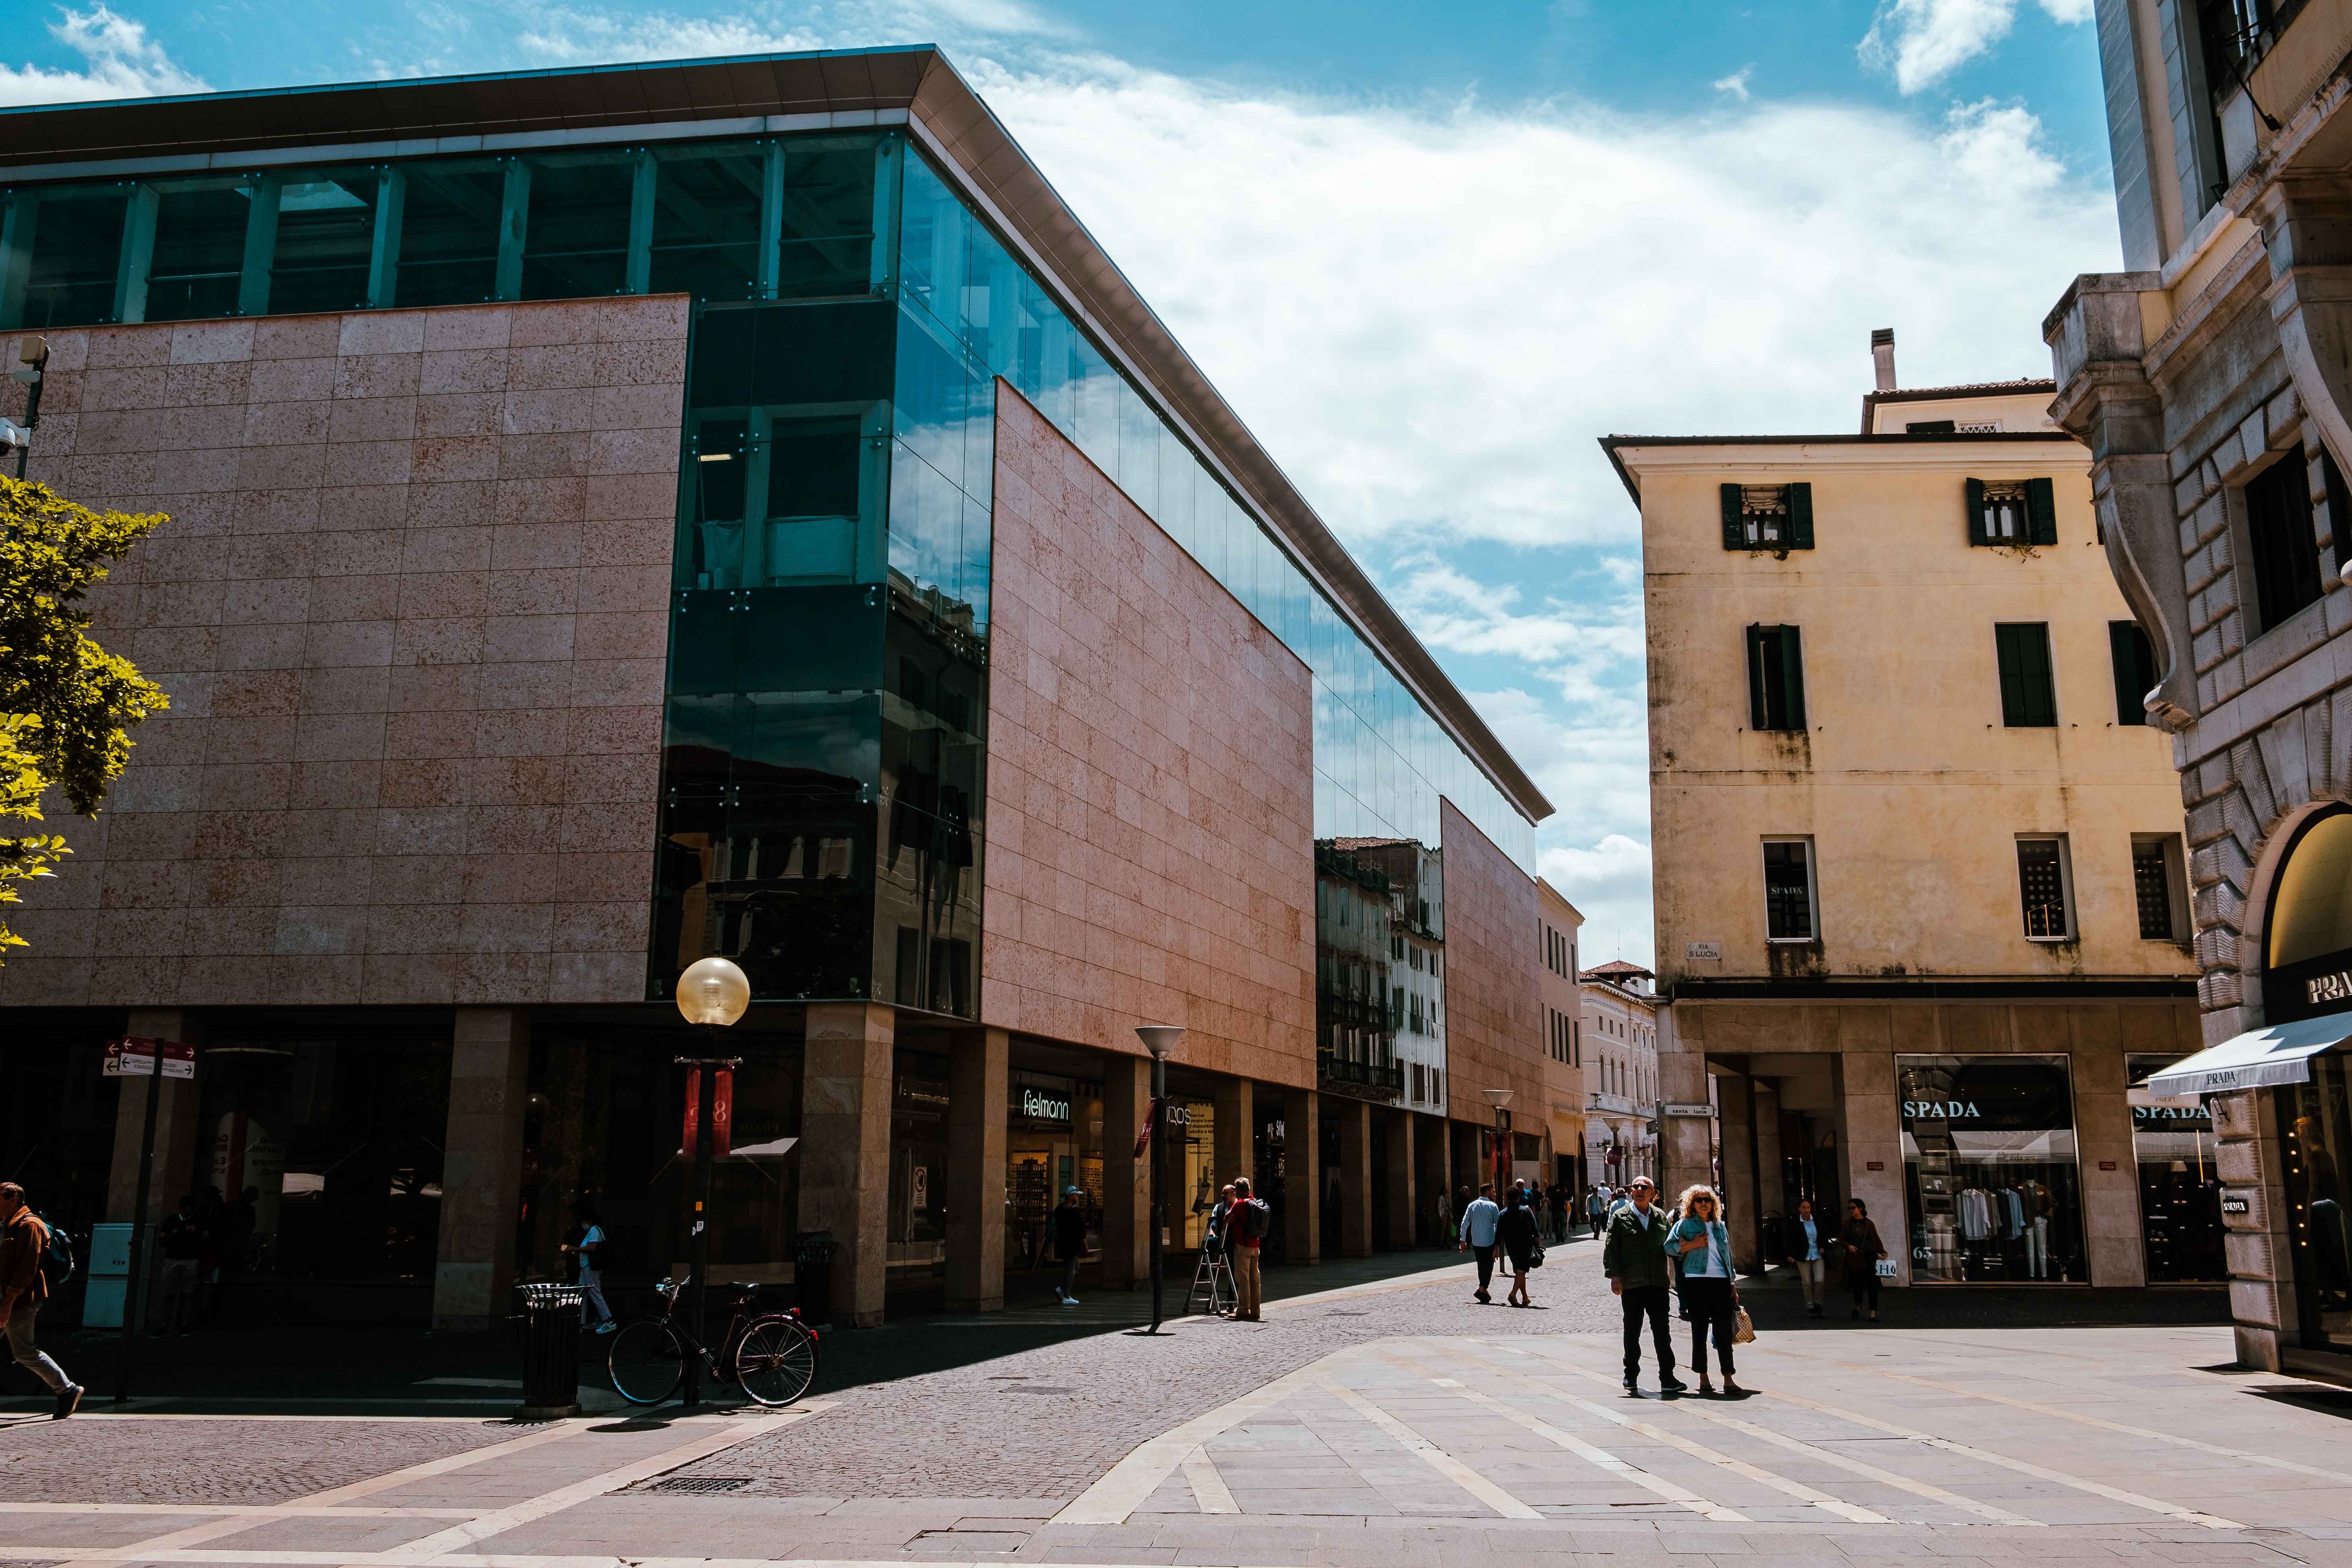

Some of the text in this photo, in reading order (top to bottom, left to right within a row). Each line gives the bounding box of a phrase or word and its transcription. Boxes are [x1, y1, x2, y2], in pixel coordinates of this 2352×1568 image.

[2305, 971, 2352, 1004] PRA
[2207, 1071, 2236, 1085] PRADA
[1024, 1089, 1069, 1120] fielmann
[1903, 1101, 1981, 1117] SPADA
[2135, 1103, 2212, 1118] SPADA
[1166, 1105, 1191, 1126] IQOS
